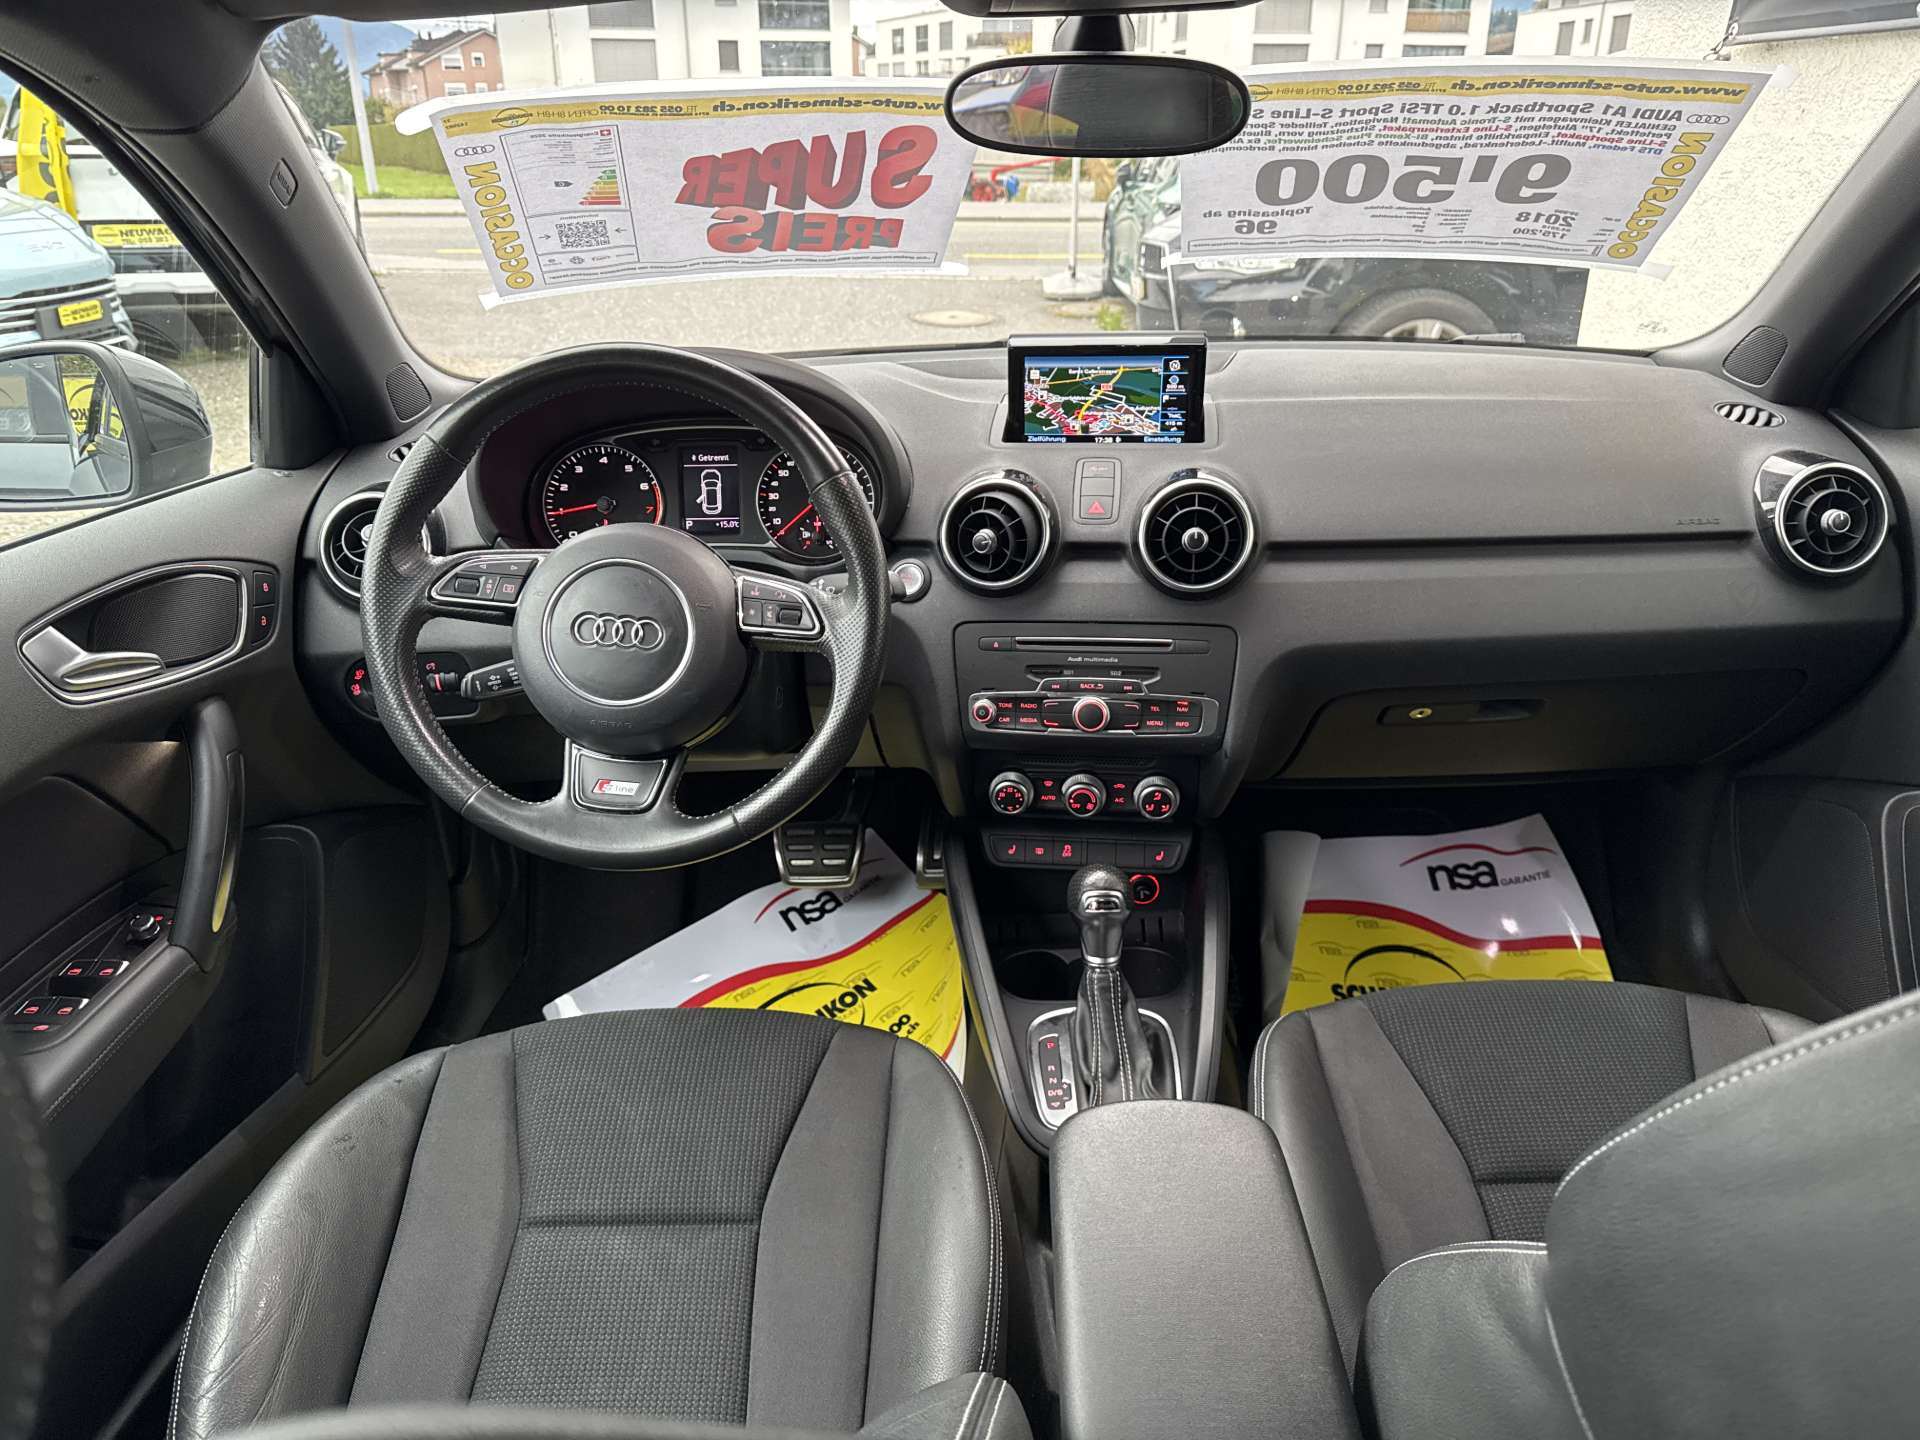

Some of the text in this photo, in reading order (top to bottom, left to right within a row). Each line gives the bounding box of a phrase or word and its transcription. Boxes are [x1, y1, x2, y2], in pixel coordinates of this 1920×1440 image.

[1027, 436, 1067, 444] Zielführung
[1144, 436, 1182, 444] Einstellung
[599, 456, 608, 464] 4
[698, 454, 729, 462] Getrennt
[574, 465, 584, 474] 3
[624, 464, 634, 472] 5
[560, 484, 569, 492] 2
[640, 482, 650, 490] 6
[768, 492, 780, 500] 30
[686, 520, 694, 530] P
[1080, 682, 1095, 690] BACK
[1427, 860, 1552, 892] nsa GARANTIE
[778, 890, 844, 932] nsa
